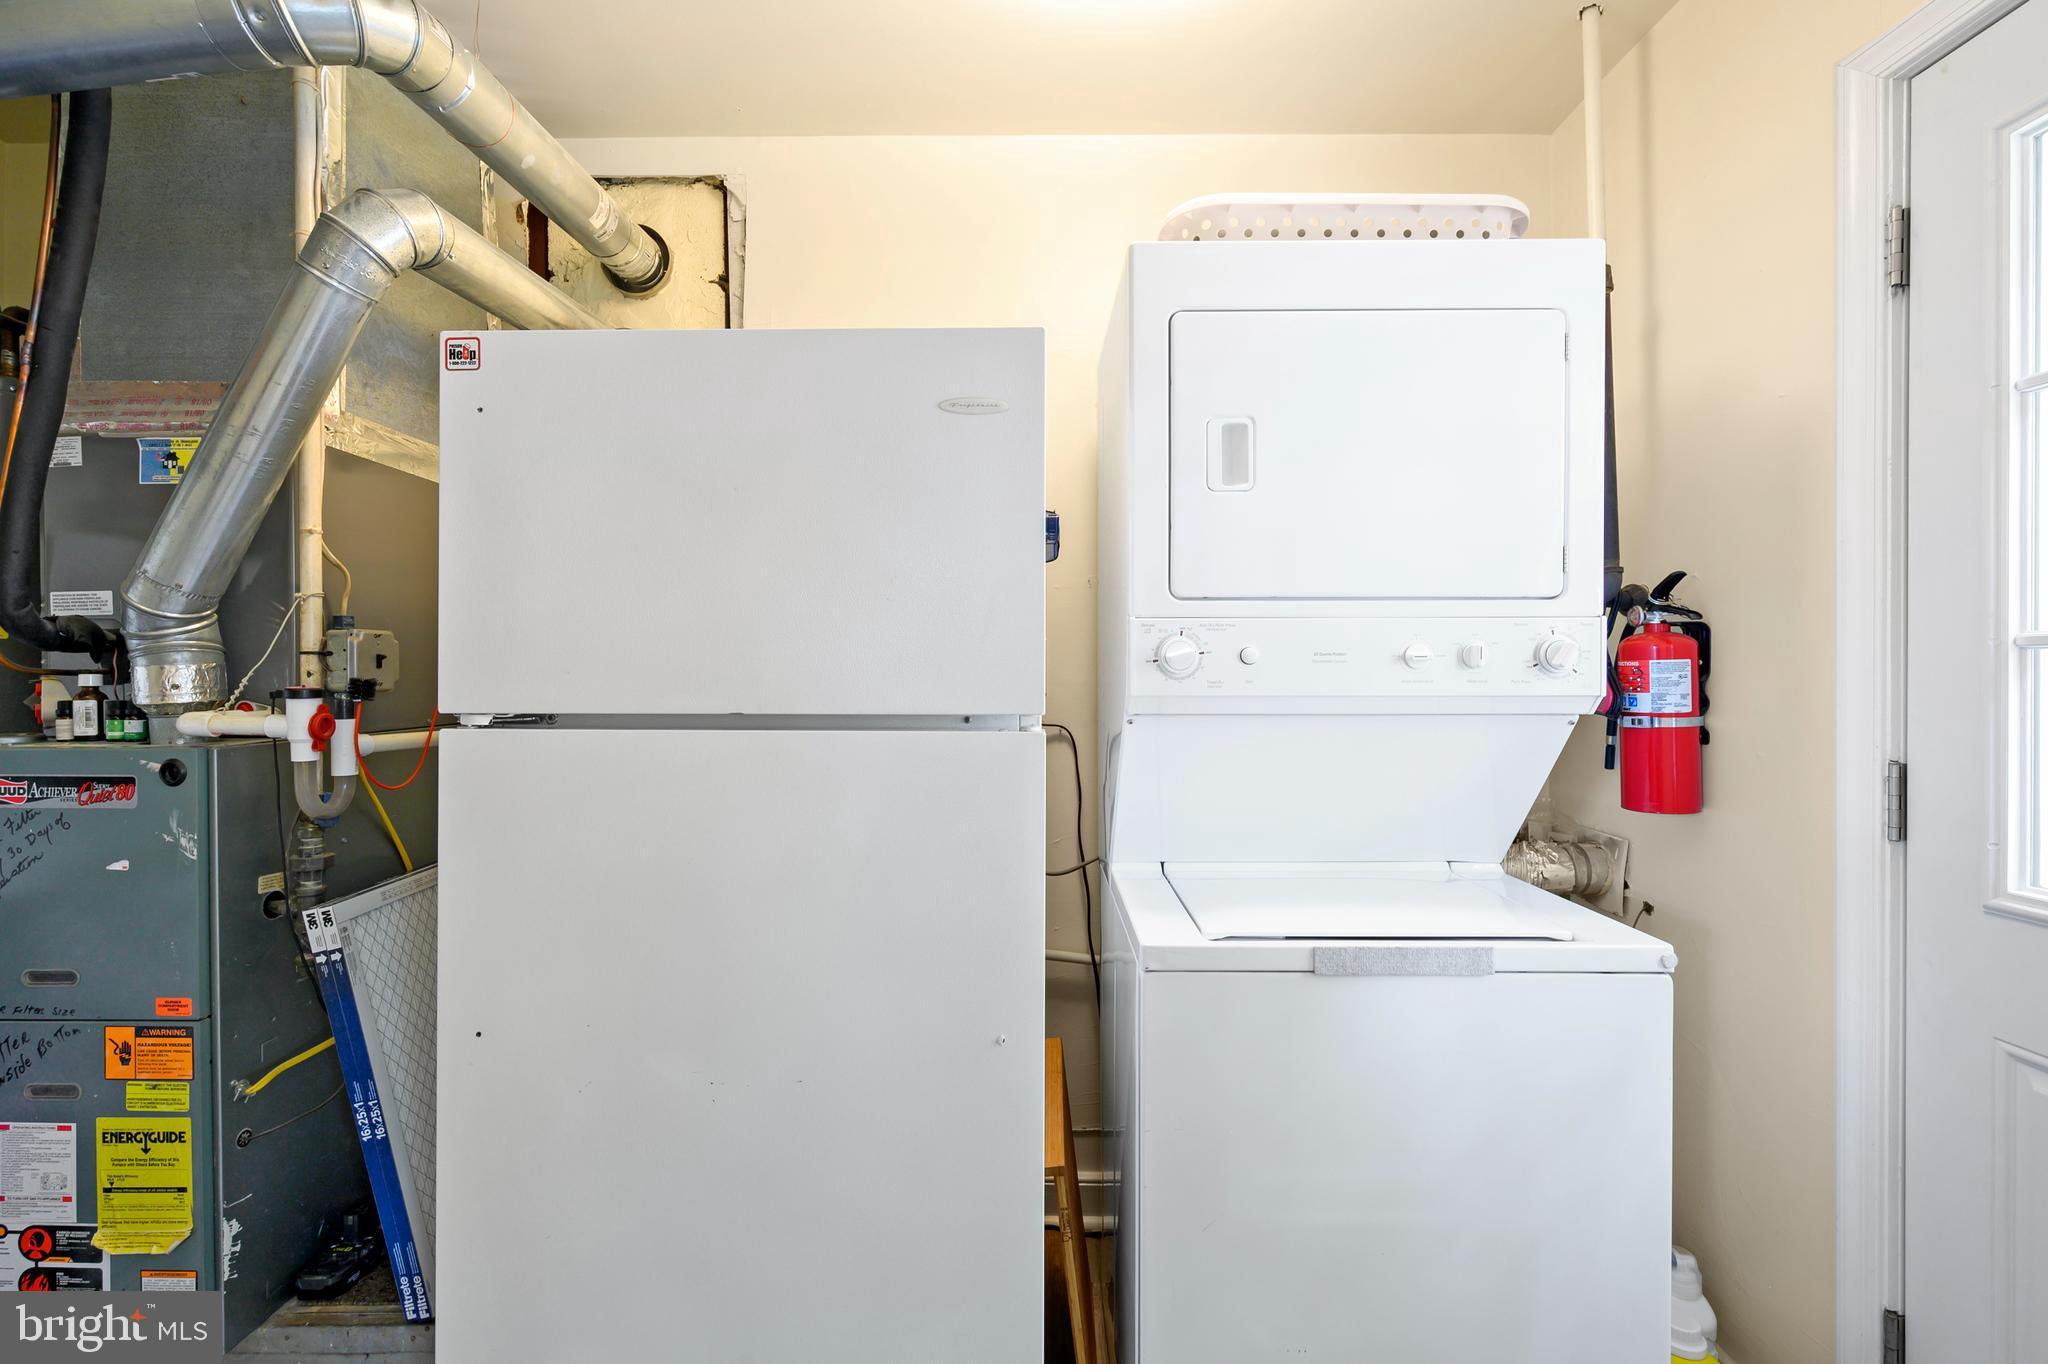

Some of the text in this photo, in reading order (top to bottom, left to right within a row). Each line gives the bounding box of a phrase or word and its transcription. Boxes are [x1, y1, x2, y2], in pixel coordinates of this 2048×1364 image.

[115, 784, 135, 801] 80
[7, 846, 22, 859] 30
[306, 912, 319, 930] 3M
[321, 910, 334, 928] 3M
[354, 1102, 372, 1142] 16x25x1
[368, 1100, 386, 1140] 16x25x1
[102, 1132, 186, 1144] ENERGYGUIDE
[400, 1276, 417, 1320] Filtrete
[413, 1275, 430, 1320] Filtrete
